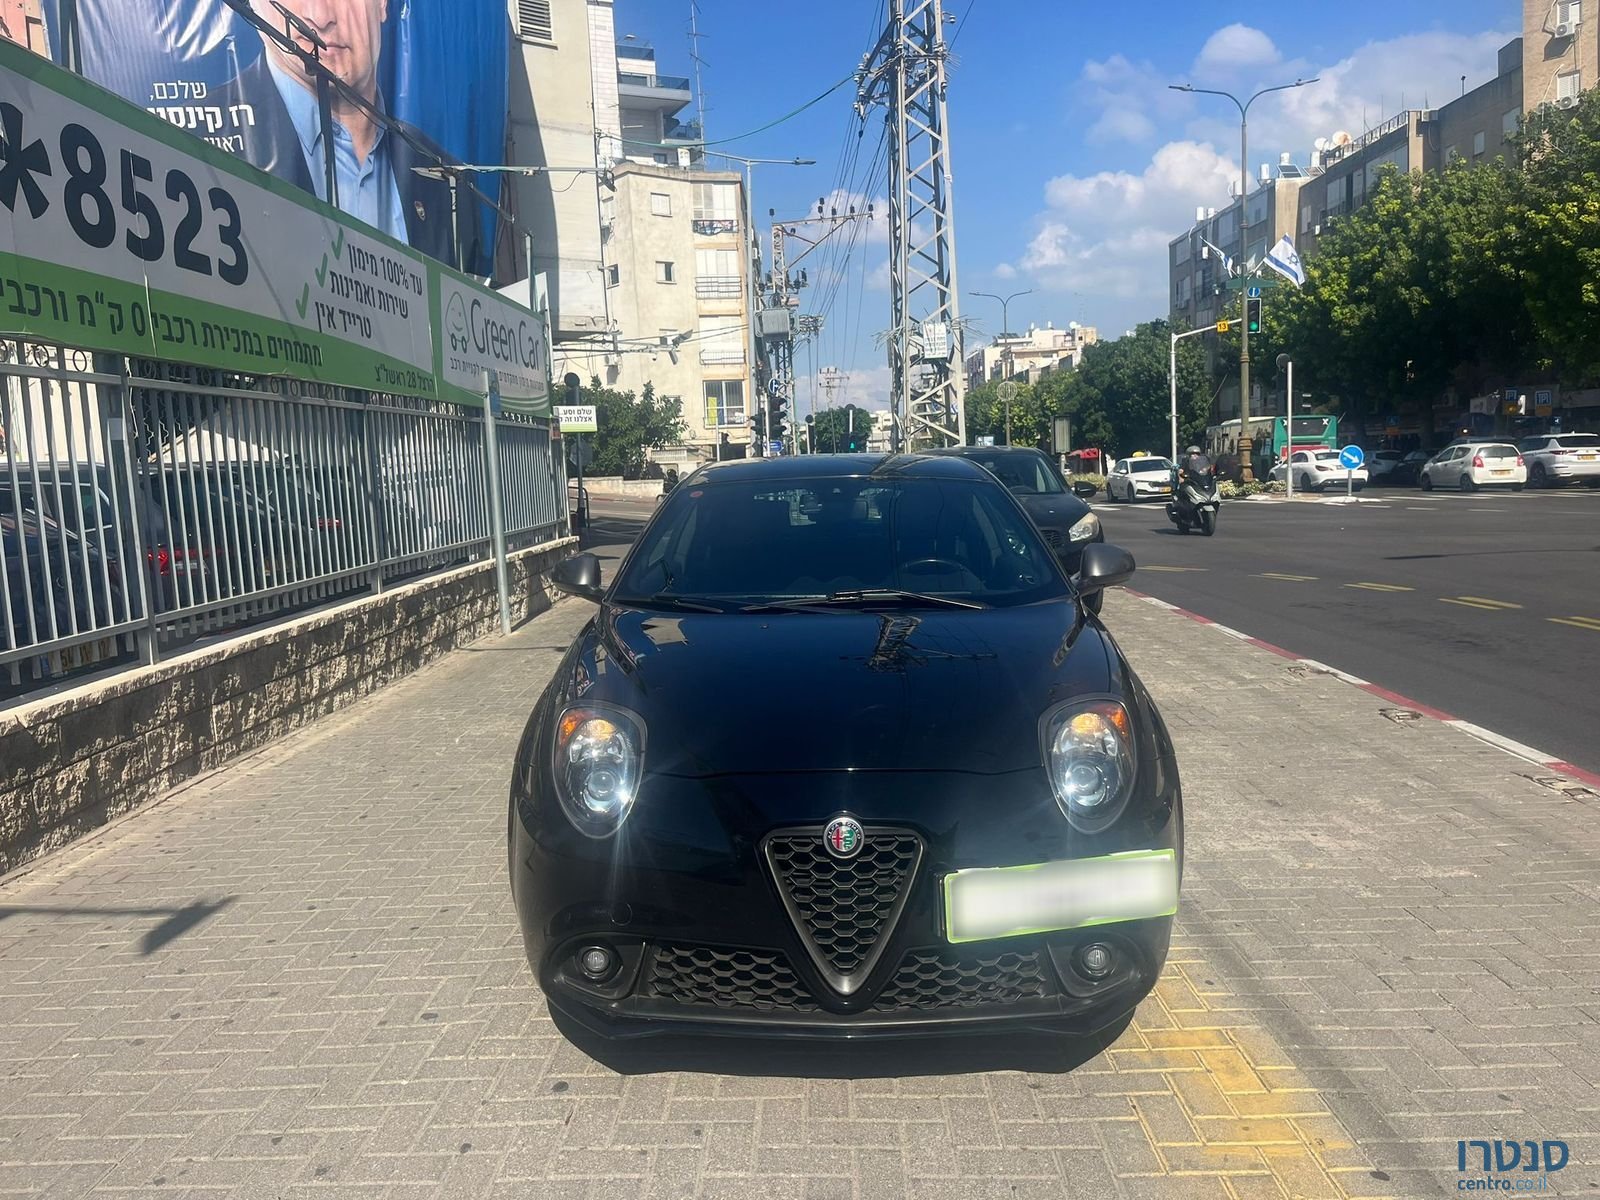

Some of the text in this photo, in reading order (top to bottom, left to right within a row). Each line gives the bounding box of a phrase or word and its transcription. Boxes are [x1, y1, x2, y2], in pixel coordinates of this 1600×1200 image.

[149, 80, 207, 101] שלכם,
[228, 104, 256, 127] רז
[347, 243, 423, 296] עד 100% מימון
[329, 270, 409, 319] שירות ואמינות
[76, 290, 124, 335] ק"מ
[150, 311, 198, 346] רכבי
[314, 301, 372, 339] טרייד אין
[1218, 322, 1227, 330] 13
[201, 321, 265, 357] במכירת
[267, 335, 323, 367] מתמחים
[470, 298, 540, 371] Green Car
[406, 370, 417, 389] 28
[450, 356, 462, 371] רכב
[576, 407, 592, 415] שלם
